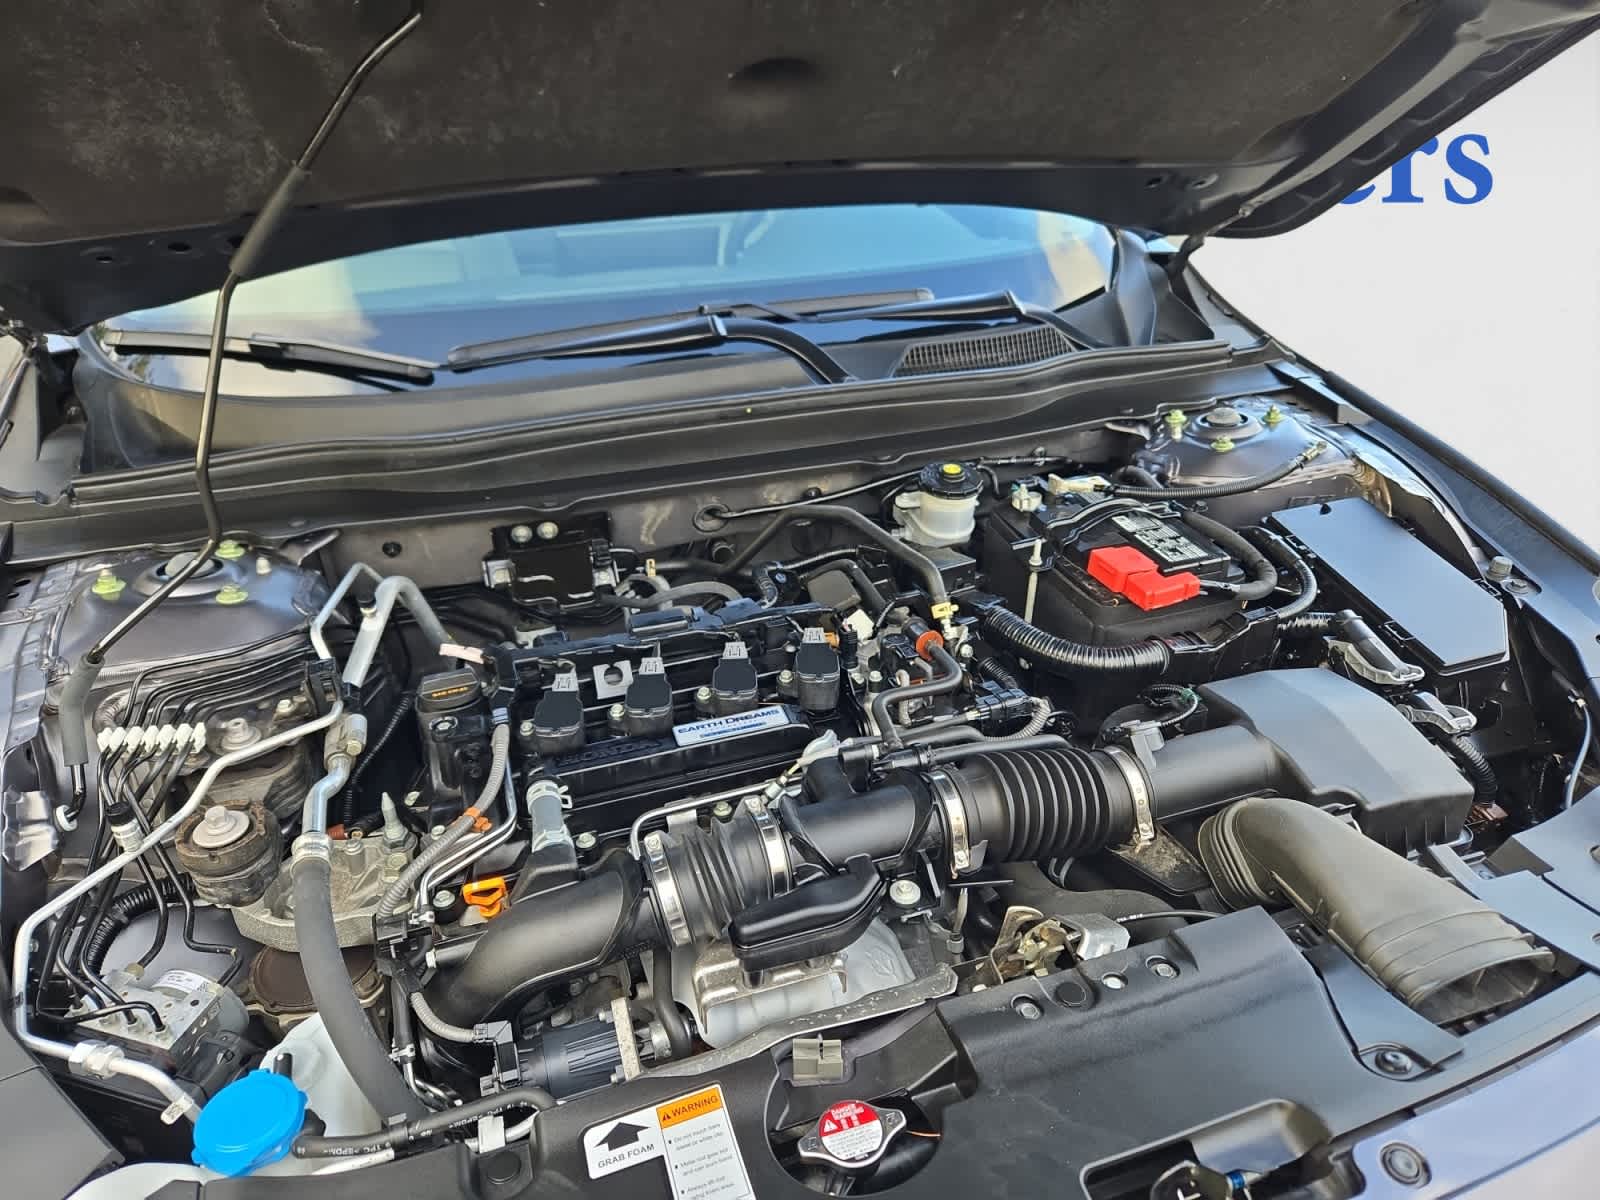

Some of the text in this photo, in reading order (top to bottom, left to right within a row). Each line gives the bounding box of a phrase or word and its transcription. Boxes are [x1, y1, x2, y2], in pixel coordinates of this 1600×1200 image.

[1339, 134, 1493, 205] rs
[678, 720, 723, 734] EARTH
[725, 708, 780, 725] DREAMS
[671, 1095, 719, 1117] WARNING
[598, 1143, 655, 1169] GRAB FOAM
